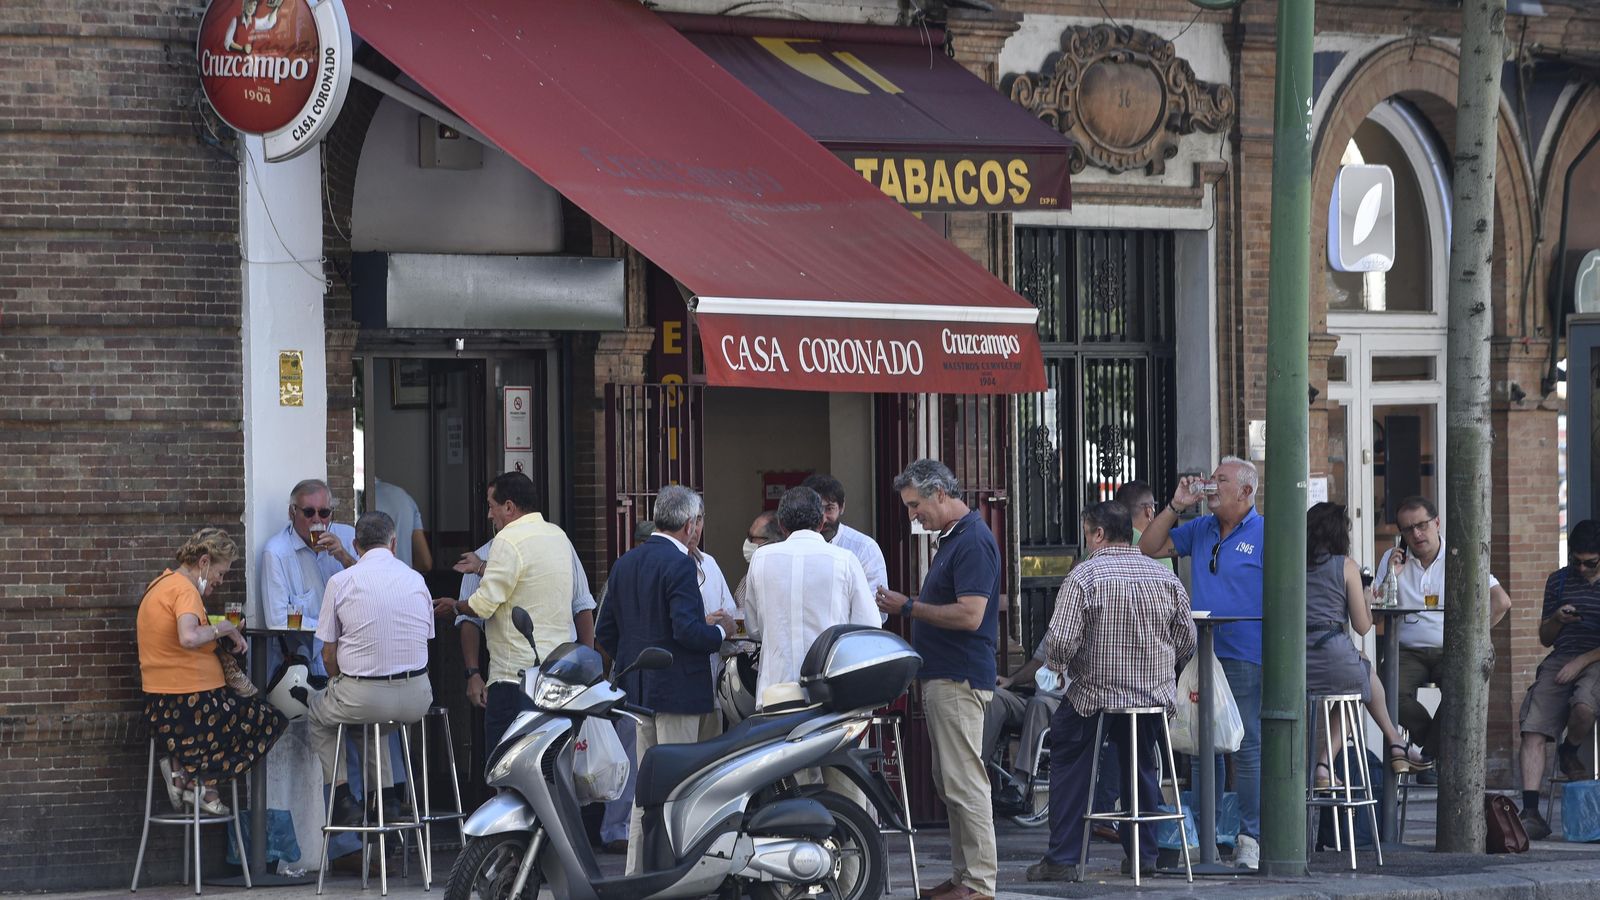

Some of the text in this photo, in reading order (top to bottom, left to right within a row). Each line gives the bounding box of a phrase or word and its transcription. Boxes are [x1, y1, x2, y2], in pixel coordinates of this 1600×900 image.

[202, 49, 308, 84] Cruzcampo
[244, 89, 272, 105] 1904
[292, 48, 335, 141] CASA CORONADO
[854, 158, 1031, 205] TABACOS
[721, 334, 924, 377] CASA CORONADO
[942, 327, 1020, 360] Cruzcampo
[1235, 541, 1255, 555] 1905
